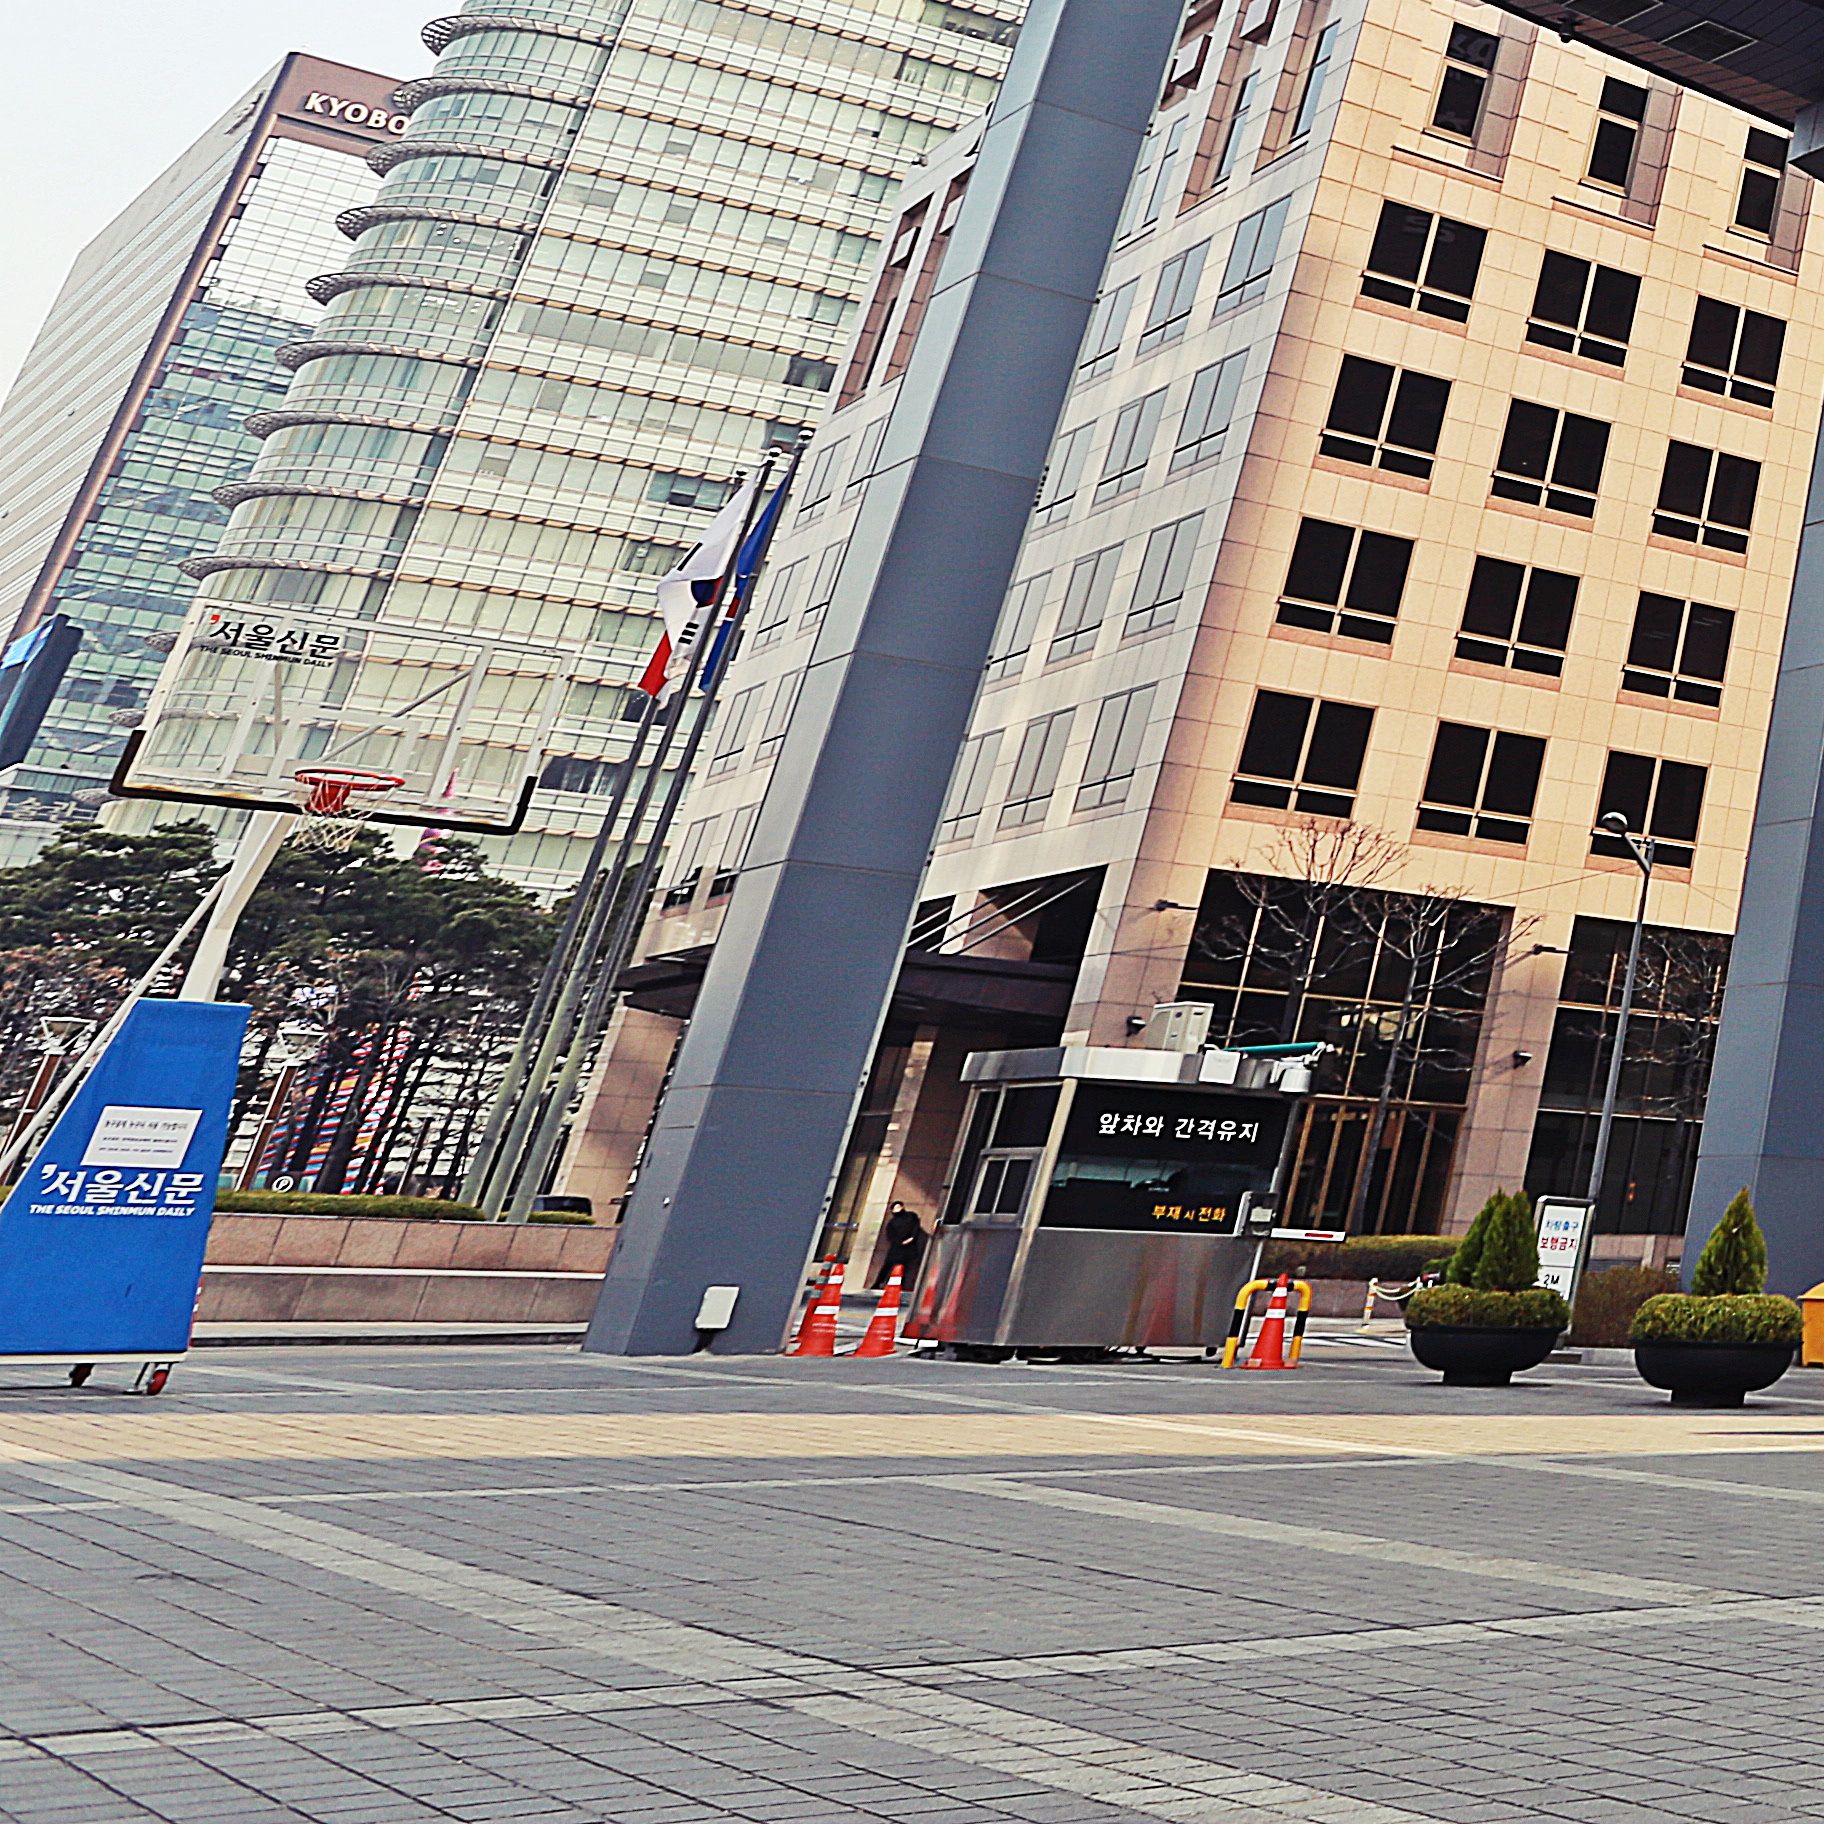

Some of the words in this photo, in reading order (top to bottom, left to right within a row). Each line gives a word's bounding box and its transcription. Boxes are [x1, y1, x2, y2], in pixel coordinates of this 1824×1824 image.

[303, 90, 410, 135] KYOBO
[200, 644, 218, 654] THE
[220, 647, 252, 658] SEOUL
[254, 652, 302, 664] SHINMUN
[303, 657, 334, 668] DAILY
[1098, 1112, 1165, 1138] 앞차와
[1174, 1117, 1259, 1143] 간격유지
[29, 1204, 54, 1215] THE
[54, 1204, 95, 1215] SEOUL
[96, 1205, 156, 1216] SHINMUN
[156, 1206, 196, 1217] DAILY
[1151, 1204, 1183, 1221] 부재
[1197, 1206, 1227, 1223] 전화
[1539, 1237, 1578, 1251] 보행금지
